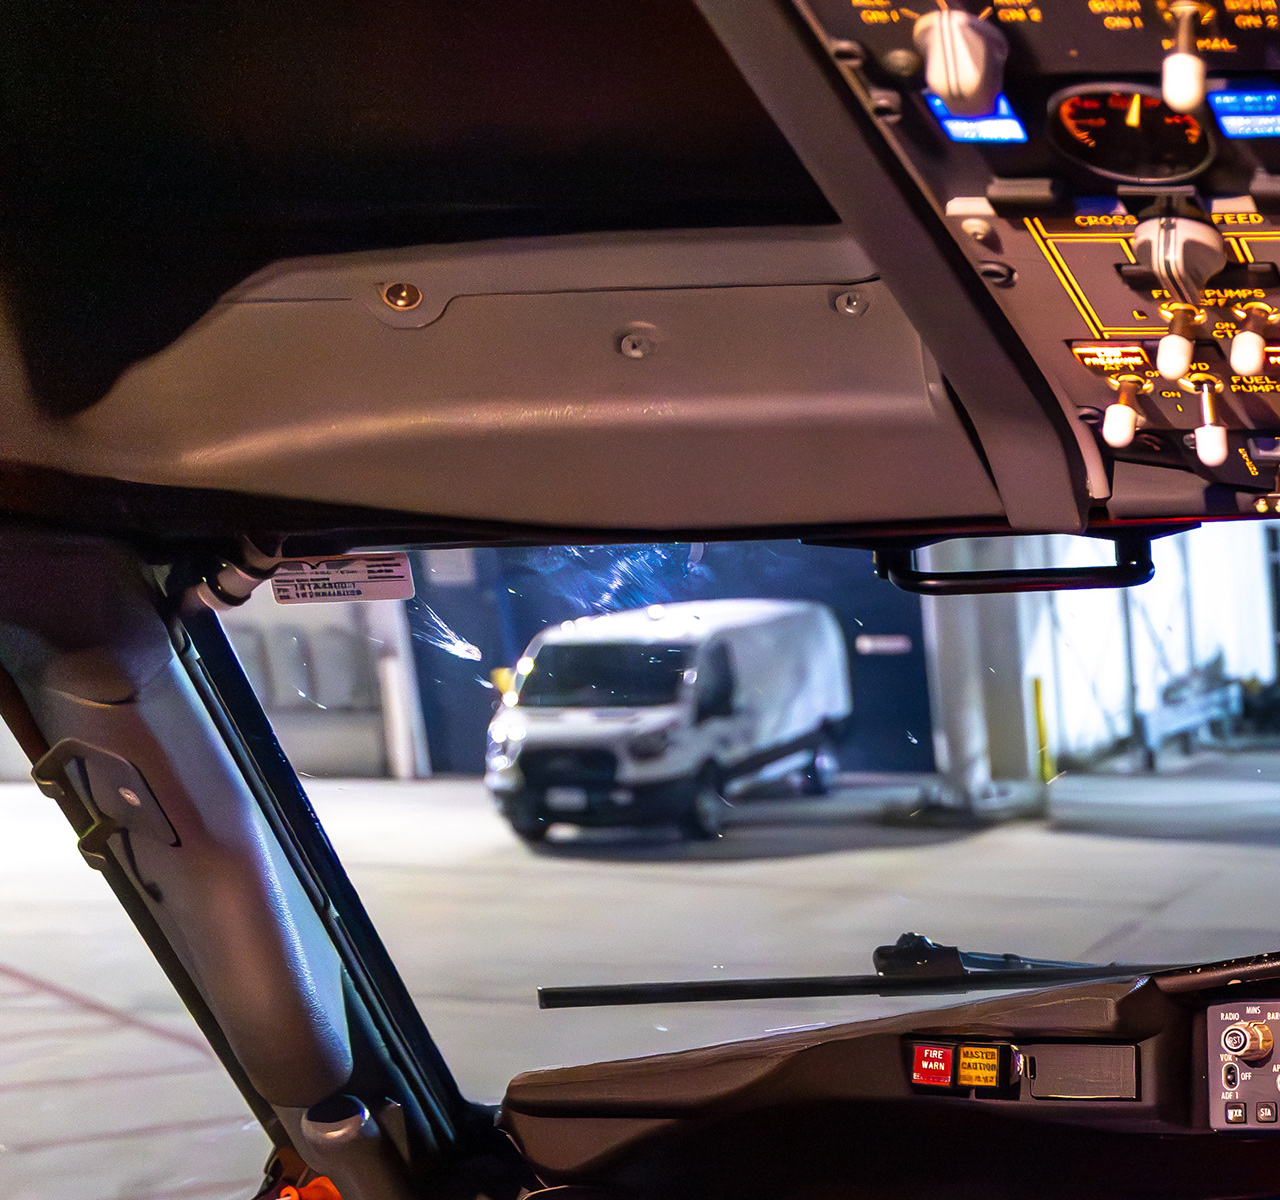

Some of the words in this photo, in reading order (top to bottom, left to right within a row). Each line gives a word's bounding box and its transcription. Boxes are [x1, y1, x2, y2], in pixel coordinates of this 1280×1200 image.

[1075, 216, 1138, 225] CROSS
[1212, 213, 1263, 224] FEED
[1205, 289, 1265, 298] PUMPS
[1231, 376, 1277, 384] FUEL
[1246, 1006, 1260, 1014] MINS
[1221, 1013, 1239, 1021] RADIO
[925, 1050, 943, 1059] FIRE
[922, 1061, 944, 1071] WARN
